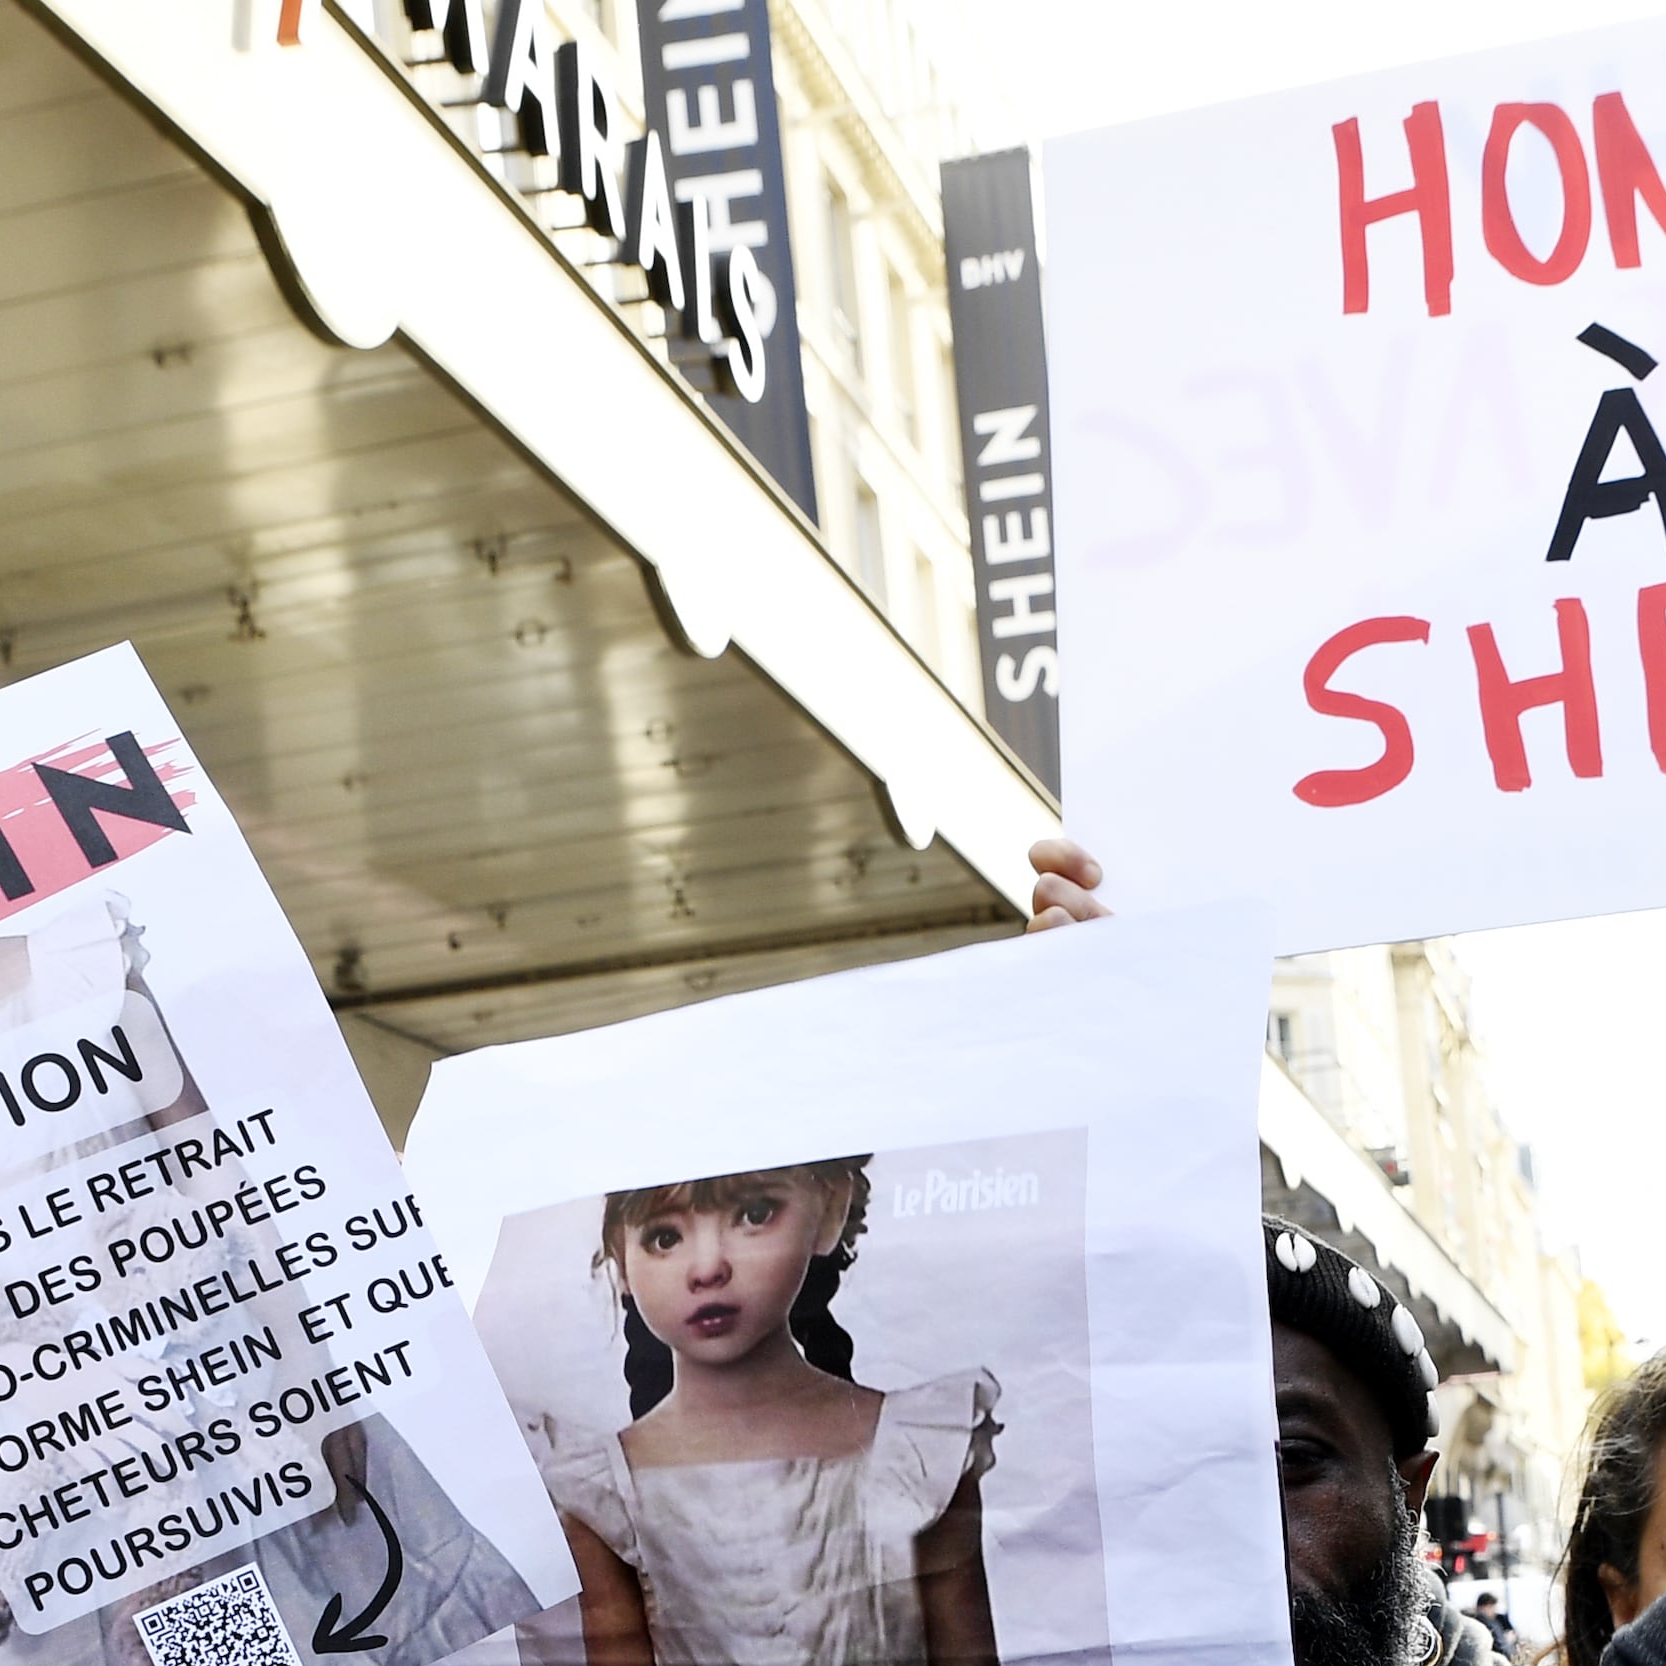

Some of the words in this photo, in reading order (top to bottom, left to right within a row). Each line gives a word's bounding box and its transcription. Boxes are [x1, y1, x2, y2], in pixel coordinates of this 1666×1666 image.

[974, 405, 1060, 703] SHEIN
[19, 1189, 82, 1239] LE
[87, 1109, 277, 1214] RETRAIT
[893, 1184, 922, 1218] Le
[924, 1168, 1038, 1215] Parisien
[5, 1256, 101, 1319] DES
[108, 1164, 327, 1278] POUPÉES
[138, 1327, 282, 1409] SHEIN
[299, 1294, 354, 1344] ET
[254, 1340, 413, 1440] SOIENT
[24, 1461, 312, 1612] POURSUIVIS
